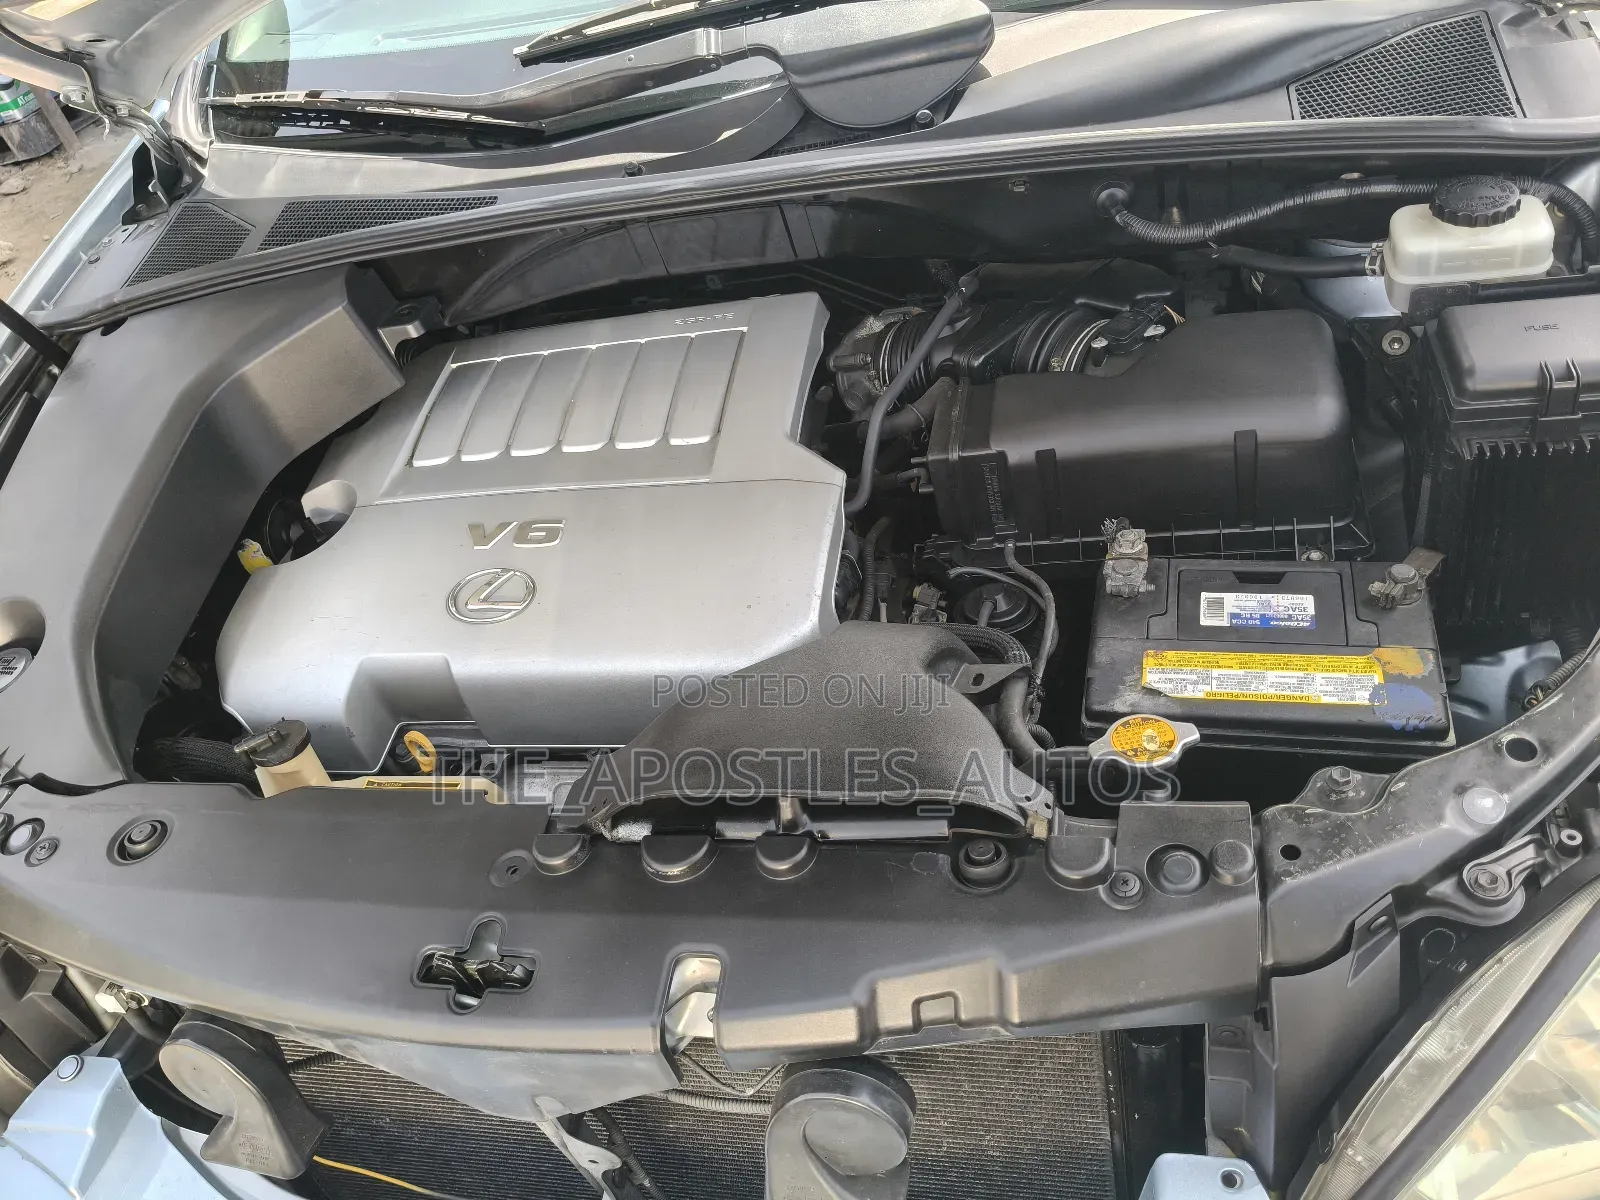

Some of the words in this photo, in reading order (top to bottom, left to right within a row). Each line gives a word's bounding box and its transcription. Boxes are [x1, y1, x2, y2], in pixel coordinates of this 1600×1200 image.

[1523, 323, 1560, 332] FUSE
[467, 519, 567, 550] V6
[1283, 605, 1309, 613] 35AC
[1291, 613, 1312, 621] 35AC
[1205, 691, 1310, 702] DANGER/POISON/PELIGRO
